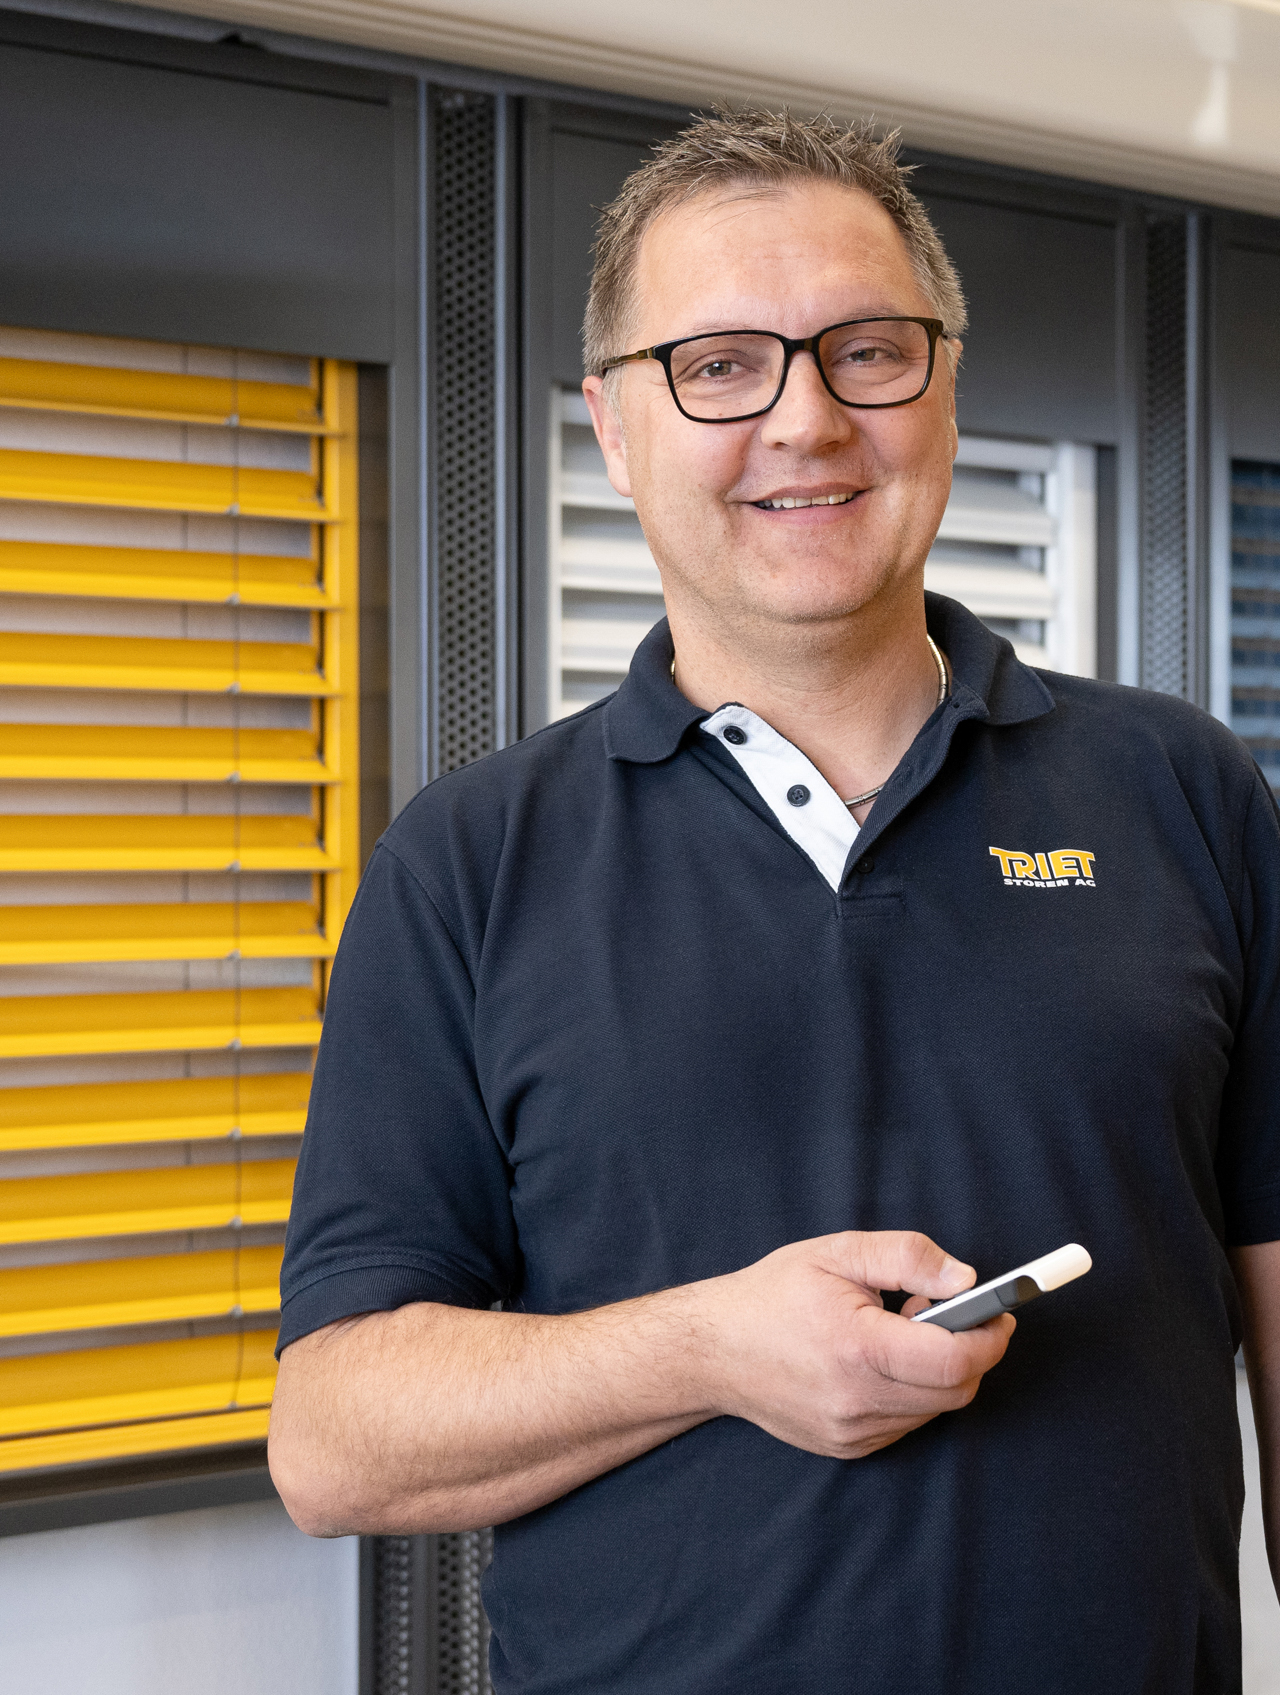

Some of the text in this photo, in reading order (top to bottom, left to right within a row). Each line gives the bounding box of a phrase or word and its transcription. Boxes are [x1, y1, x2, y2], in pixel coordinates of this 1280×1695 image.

[989, 846, 1096, 880] TRIET
[1003, 879, 1097, 888] STOREN AG
